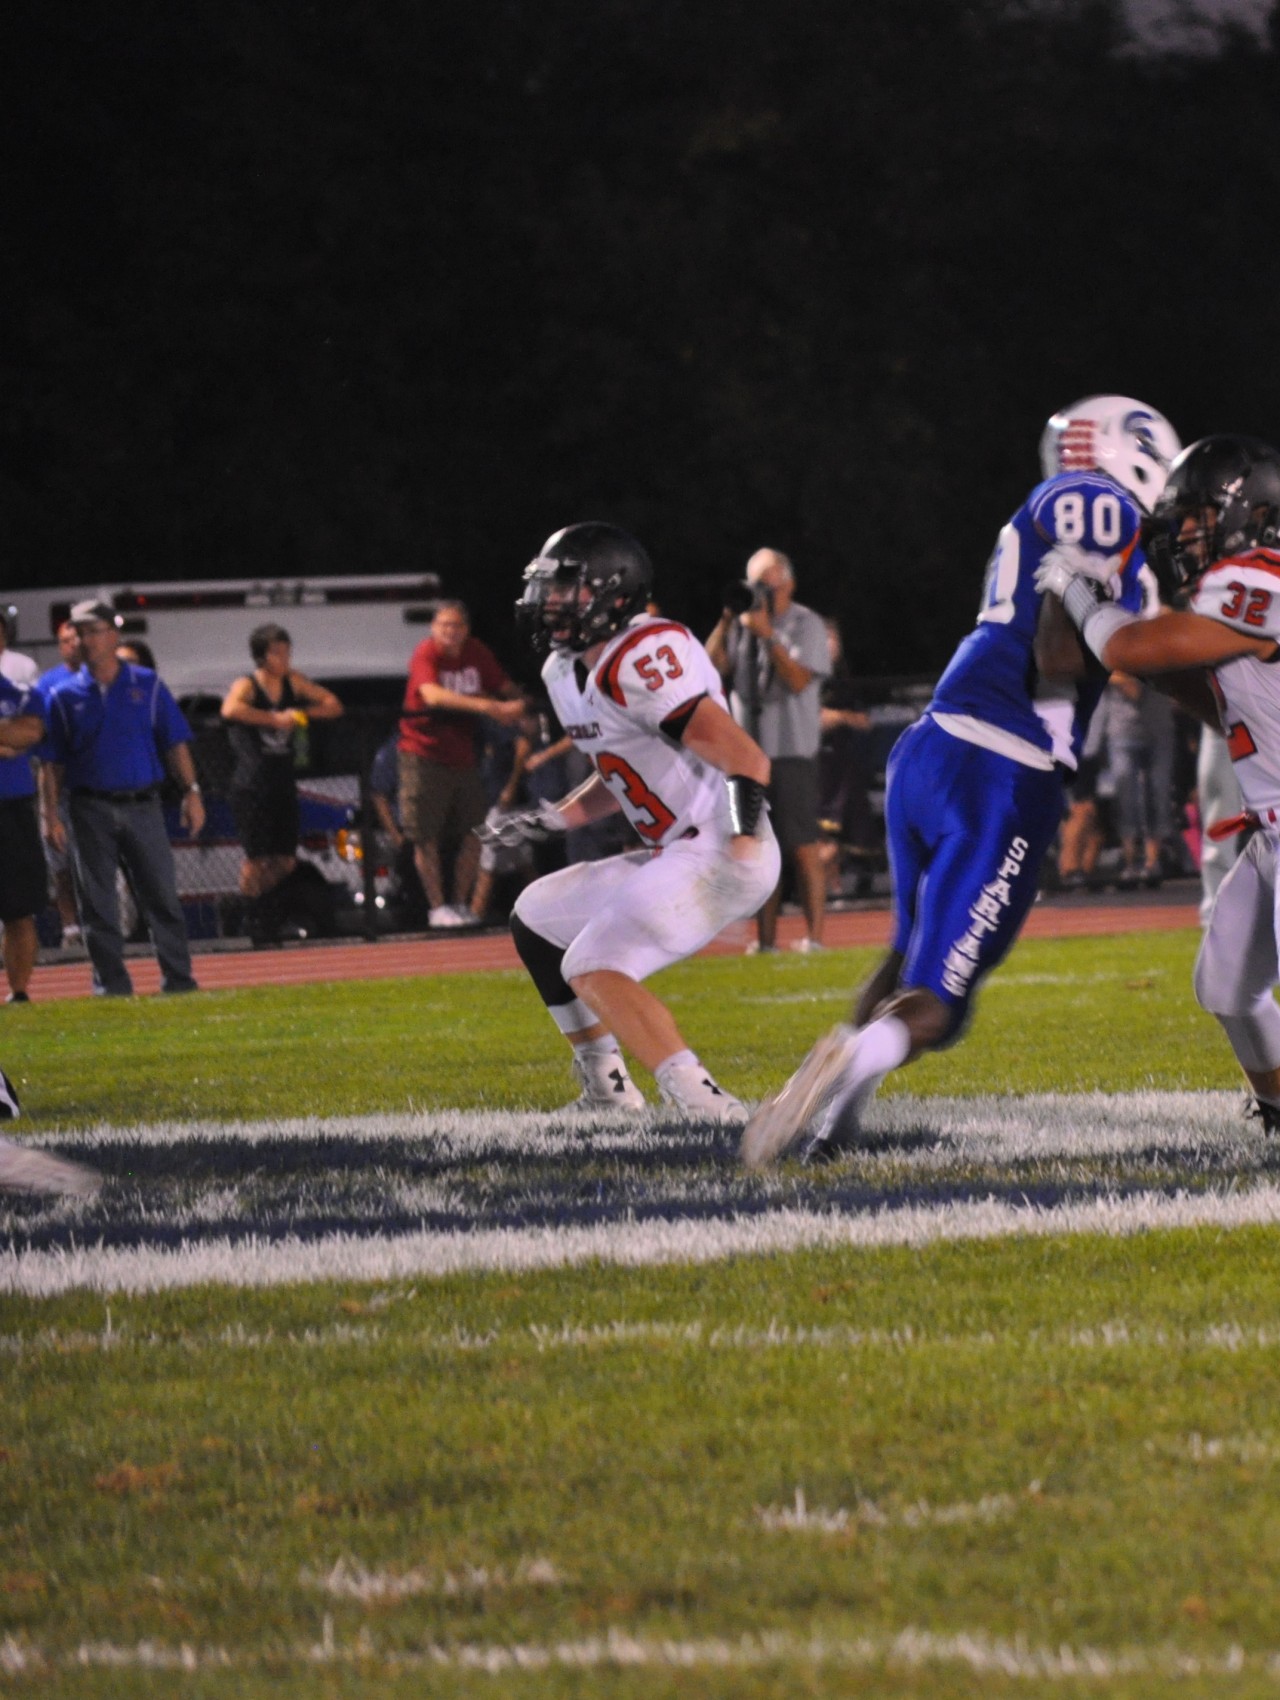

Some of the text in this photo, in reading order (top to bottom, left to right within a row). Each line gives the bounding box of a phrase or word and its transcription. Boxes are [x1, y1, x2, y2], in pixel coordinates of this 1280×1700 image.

[1054, 492, 1121, 547] 80
[1221, 581, 1272, 627] 32
[633, 645, 684, 692] 53
[590, 751, 678, 841] 3
